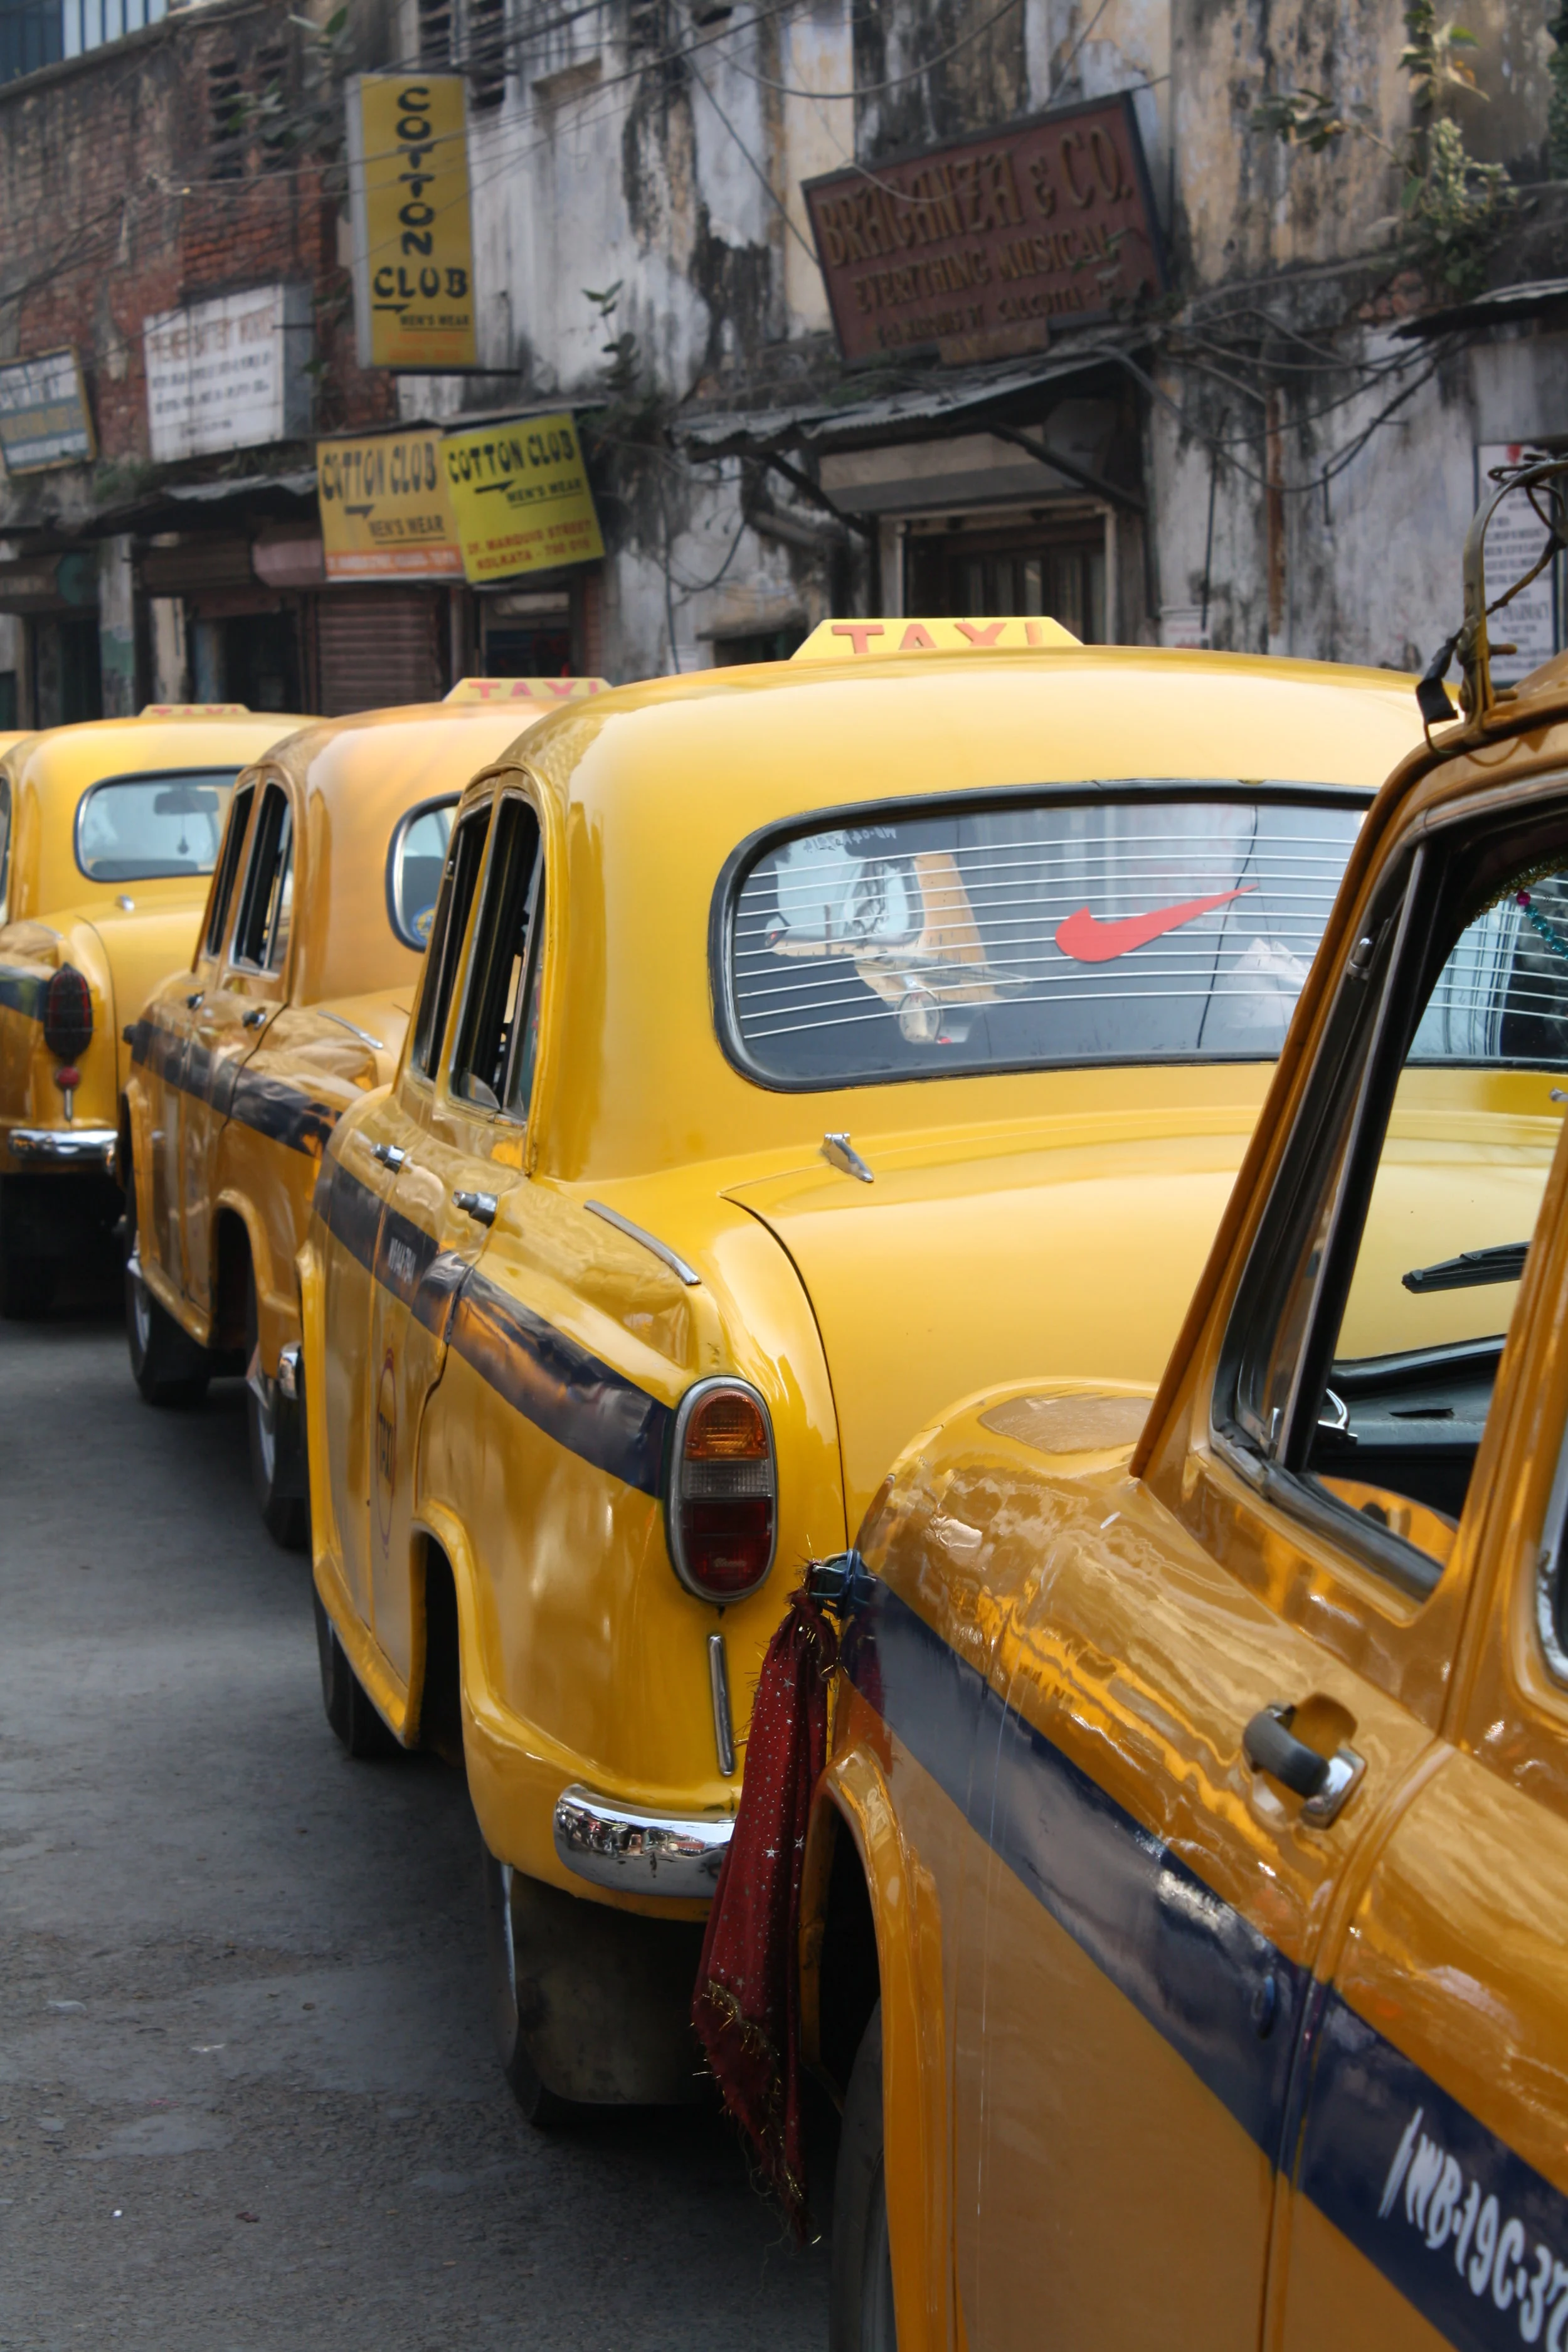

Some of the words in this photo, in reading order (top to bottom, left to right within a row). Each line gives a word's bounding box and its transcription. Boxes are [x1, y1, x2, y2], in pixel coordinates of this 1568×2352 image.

[395, 87, 435, 256] COTTON
[817, 149, 1025, 267] BRAGANZA
[1059, 126, 1133, 209] CO.
[373, 267, 469, 299] CLUB
[851, 247, 992, 314] EVERYTHING
[997, 223, 1114, 279] MUSICAL
[439, 315, 469, 326] WEAR
[322, 449, 385, 500] COTTON
[390, 443, 437, 495] CLUB
[448, 440, 524, 484] COTTON
[527, 430, 575, 467] CLUB
[506, 484, 546, 503] MEN'S
[548, 477, 583, 494] WEAR
[369, 518, 405, 538] MEN'S
[406, 515, 444, 534] WEAR
[832, 622, 1044, 654] TAXI
[469, 681, 599, 699] TAXI
